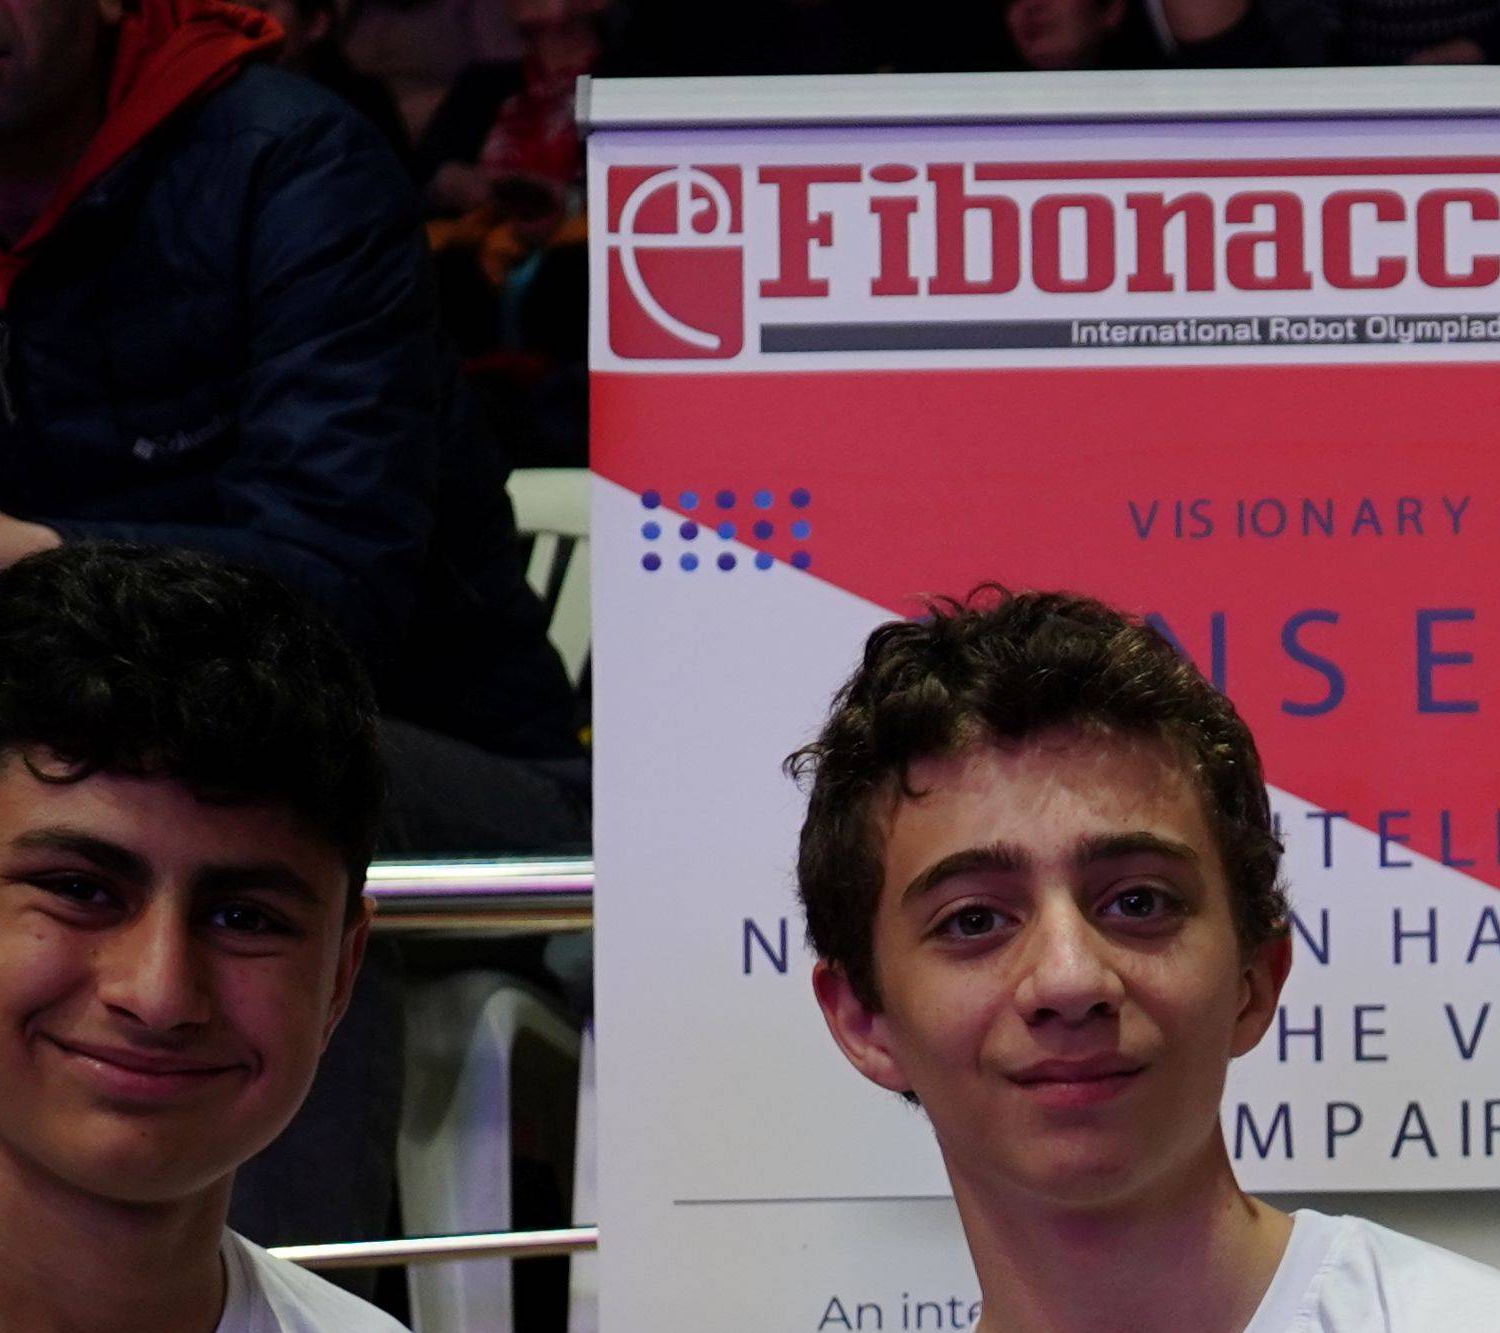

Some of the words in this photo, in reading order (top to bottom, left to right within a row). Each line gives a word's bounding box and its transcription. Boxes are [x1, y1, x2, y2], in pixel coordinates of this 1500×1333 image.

[1070, 315, 1261, 346] International
[1268, 314, 1358, 343] Robot
[1127, 494, 1472, 540] VISIONARY
[1276, 1003, 1389, 1063] HE
[817, 1295, 884, 1332] An
[901, 1291, 982, 1332] inte
